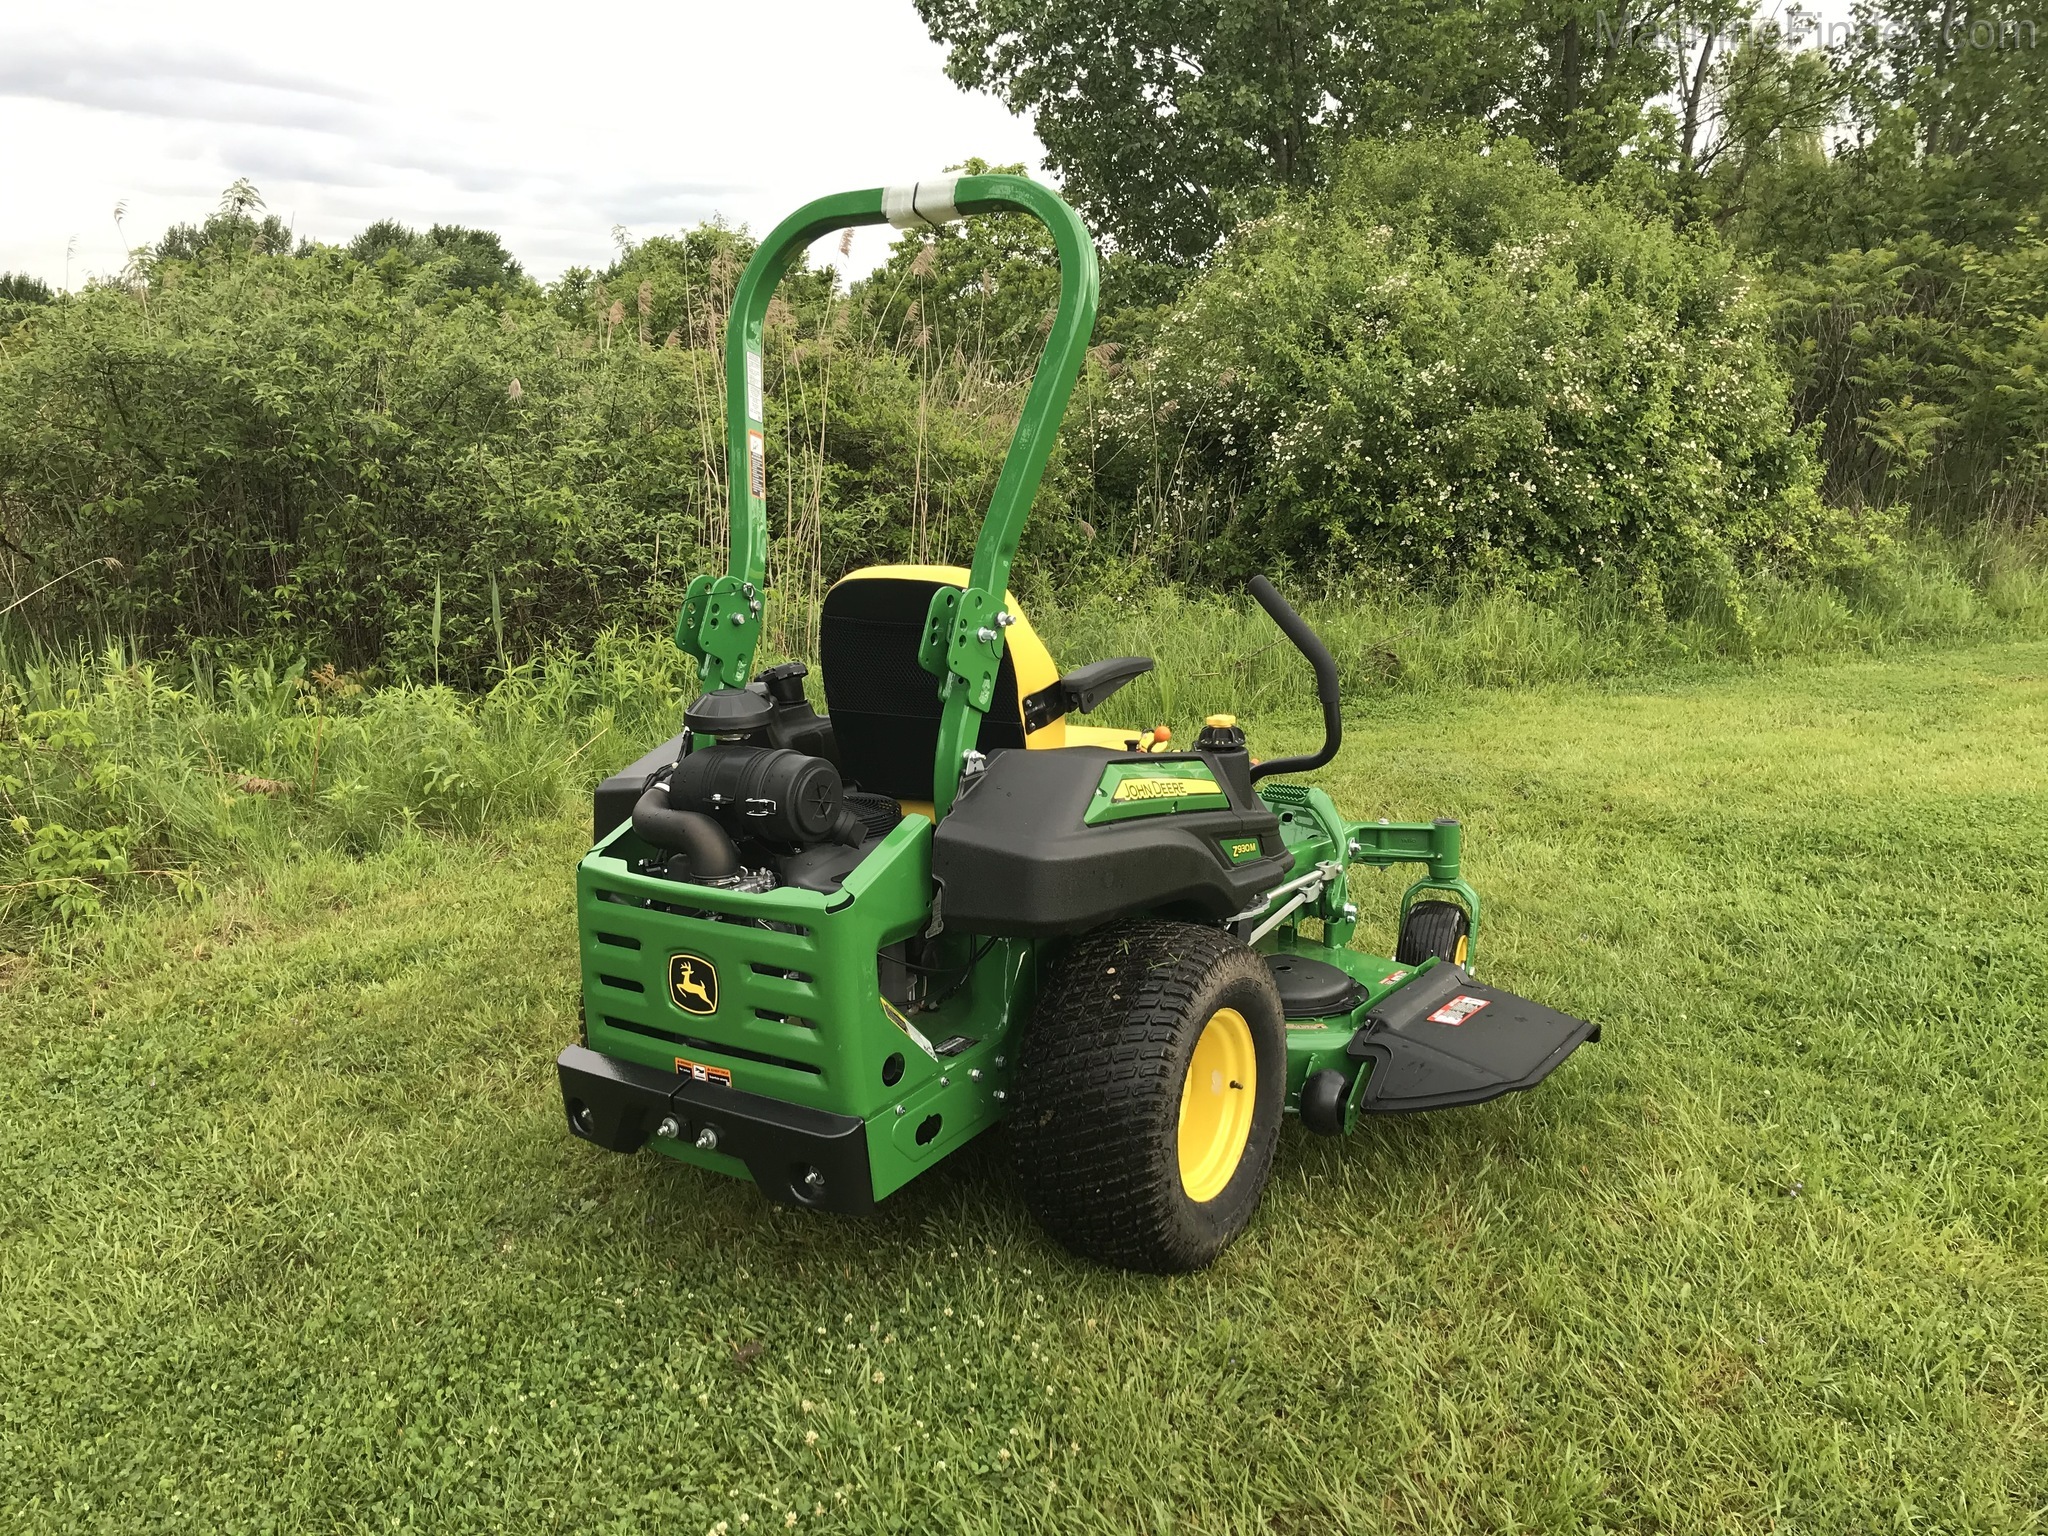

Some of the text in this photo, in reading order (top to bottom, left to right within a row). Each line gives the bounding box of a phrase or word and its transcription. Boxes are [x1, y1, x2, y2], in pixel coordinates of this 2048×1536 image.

[1125, 781, 1187, 798] JOHN DEERE
[1232, 843, 1256, 857] Z930M
